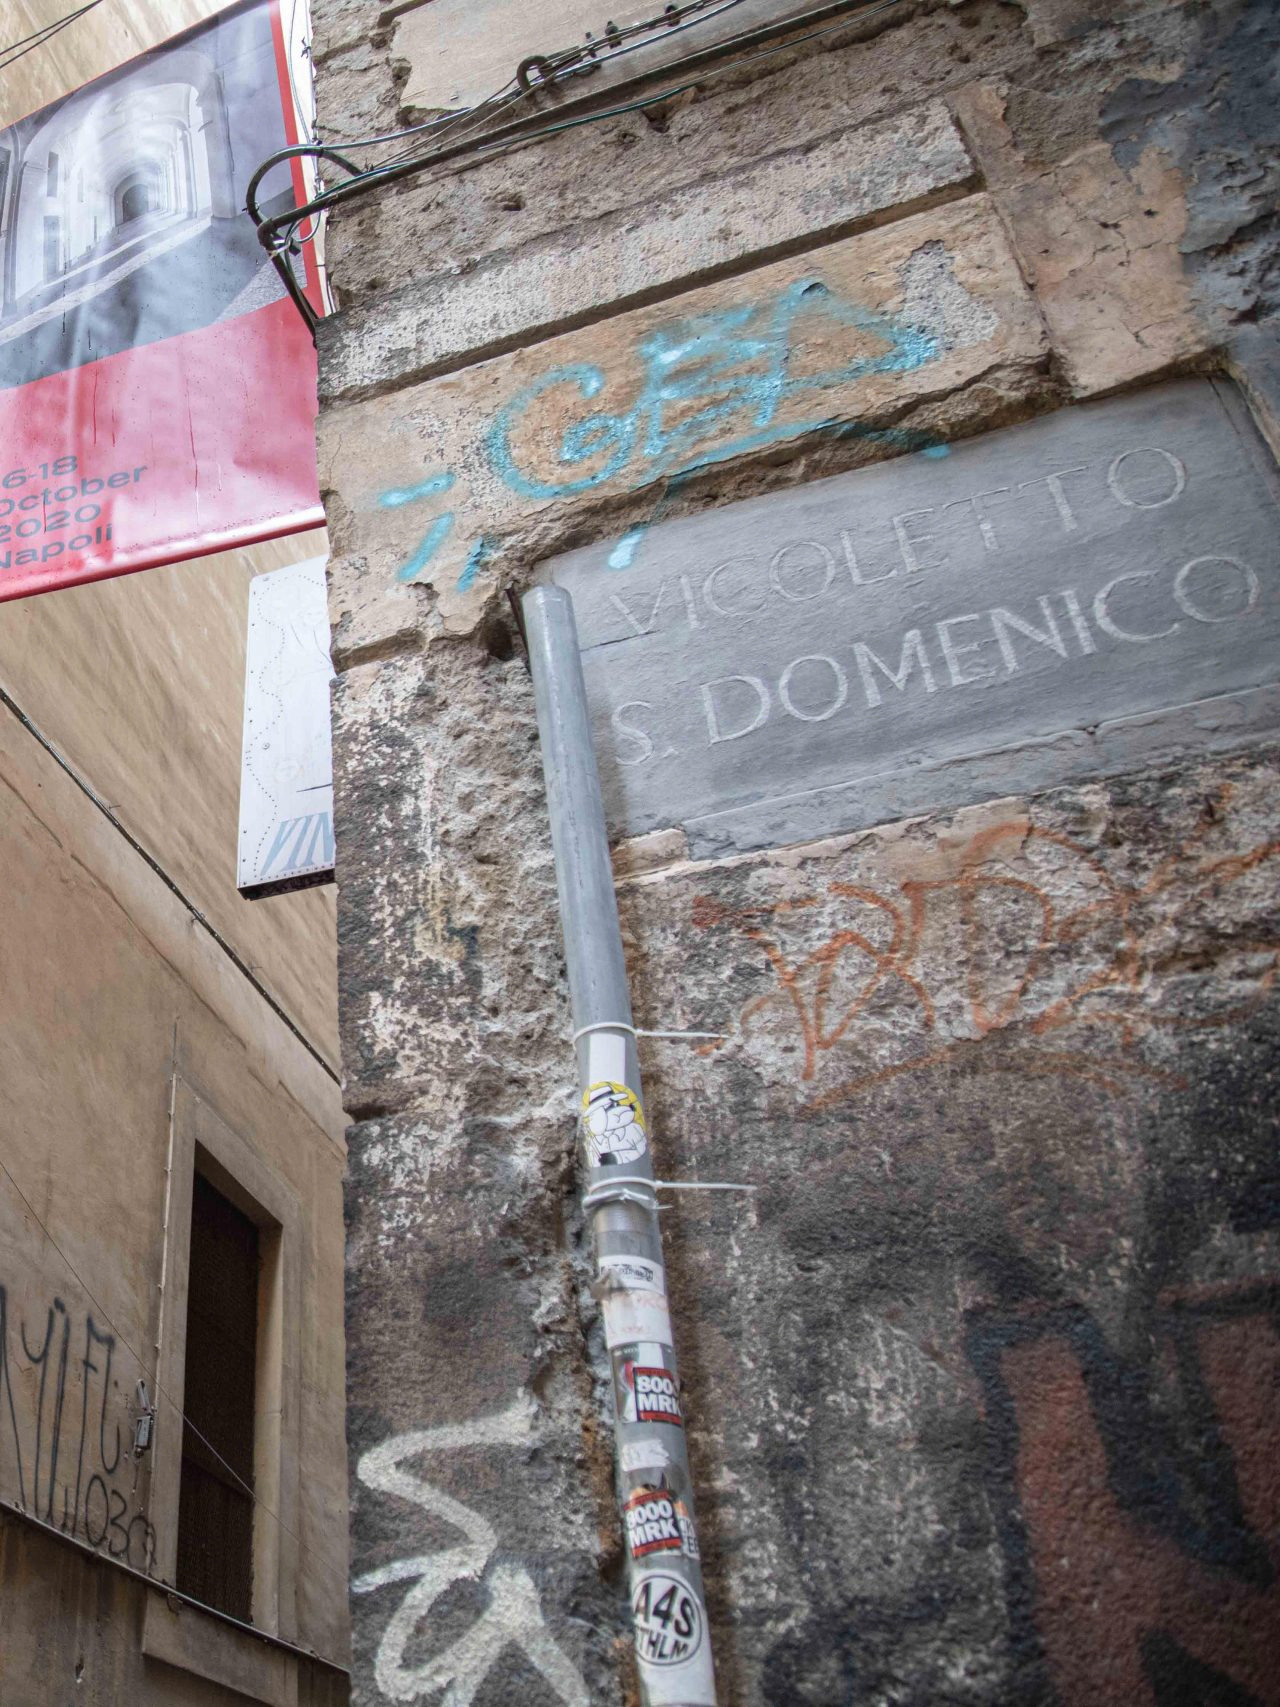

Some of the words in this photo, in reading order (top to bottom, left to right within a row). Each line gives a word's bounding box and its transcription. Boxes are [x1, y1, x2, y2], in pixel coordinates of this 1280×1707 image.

[610, 446, 1189, 638] VICOLETTO
[612, 699, 677, 768] S.
[700, 555, 1261, 747] DOMENICO
[628, 1518, 680, 1549] MRK
[634, 1581, 697, 1639] A4S
